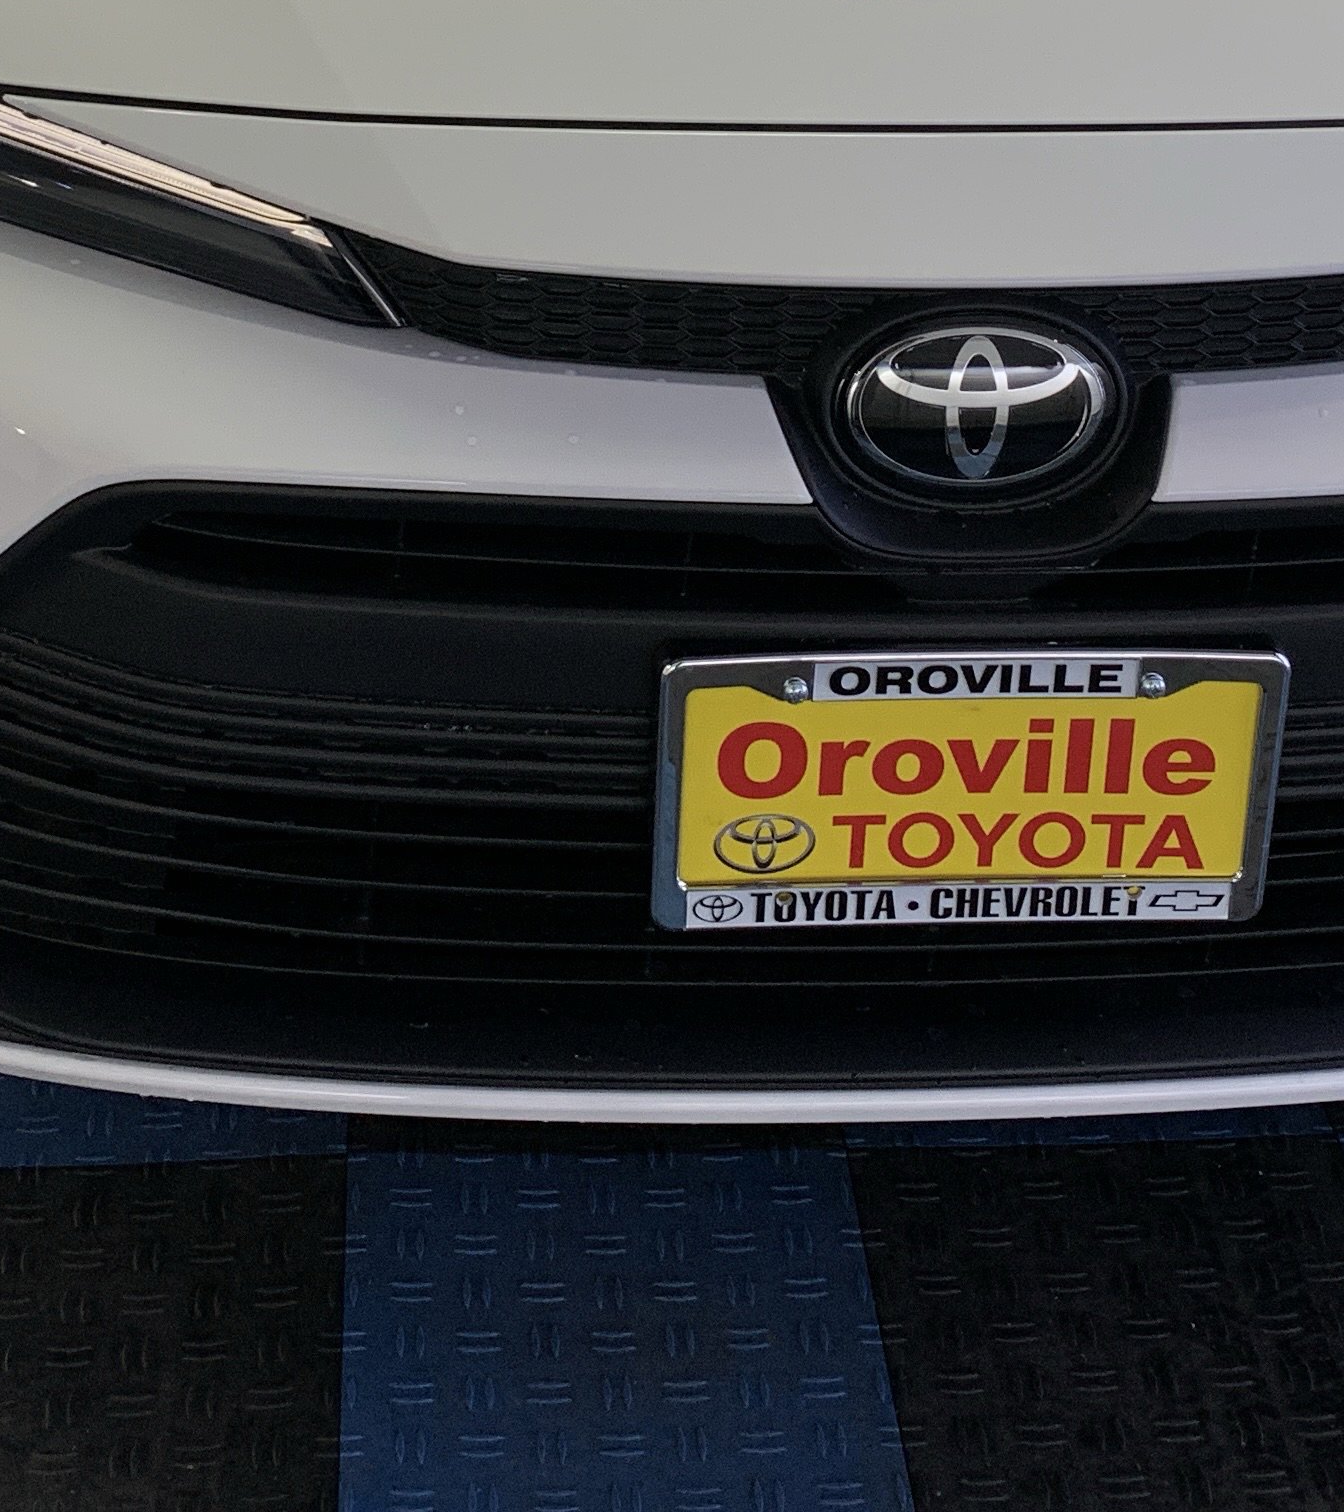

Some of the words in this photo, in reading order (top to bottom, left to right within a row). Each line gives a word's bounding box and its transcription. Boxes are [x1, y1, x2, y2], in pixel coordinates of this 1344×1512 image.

[828, 663, 1123, 695] OROVILLE
[717, 718, 1216, 800] Oroville
[832, 811, 1205, 870] TOYOTA
[751, 891, 896, 923] TOYOTA
[929, 885, 1146, 919] CHEVROLET
